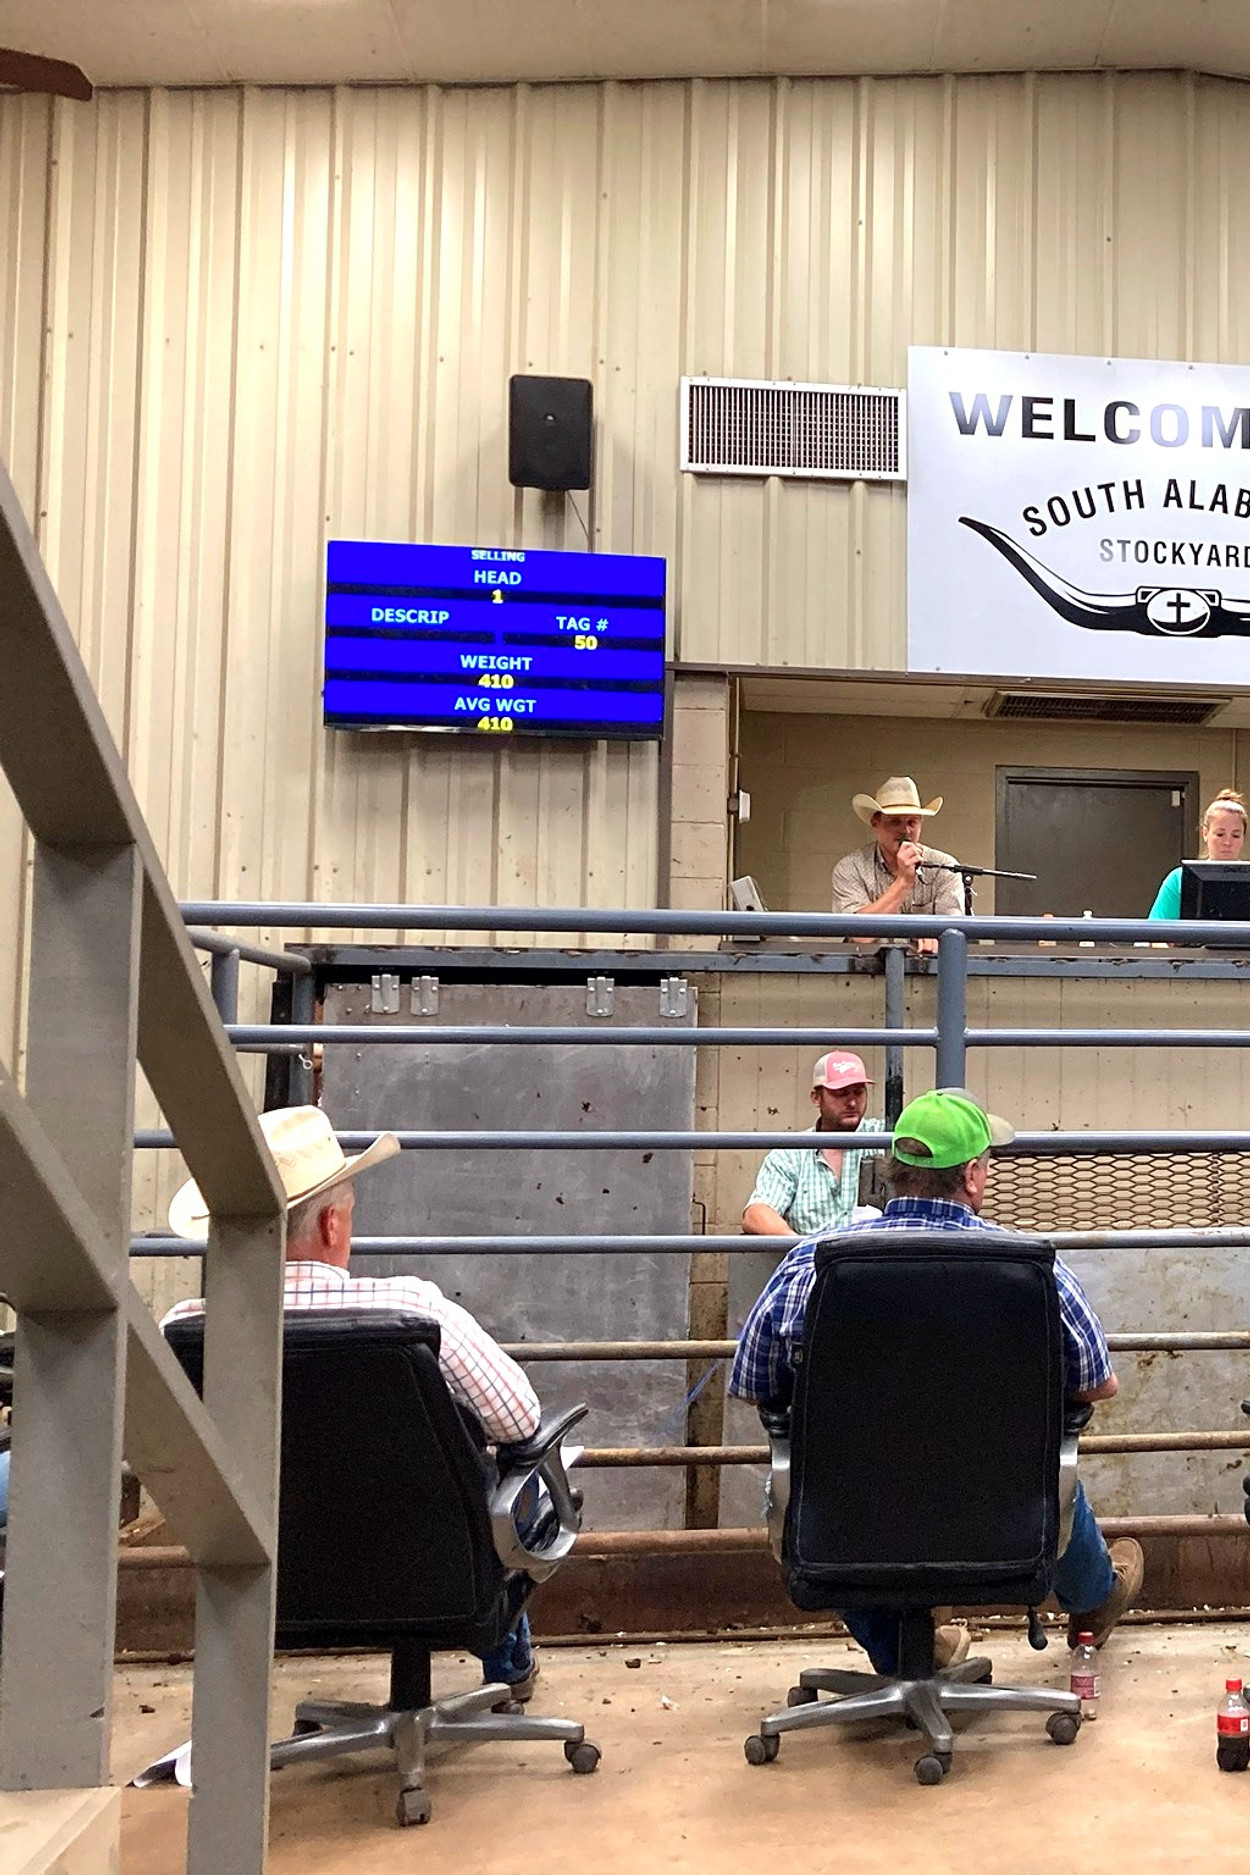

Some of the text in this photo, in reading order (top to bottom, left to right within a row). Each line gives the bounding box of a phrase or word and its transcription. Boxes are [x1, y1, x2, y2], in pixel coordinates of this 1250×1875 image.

[1022, 478, 1146, 537] SOUTH
[471, 549, 526, 563] SELLING
[473, 570, 522, 586] HEAD
[491, 589, 504, 604] 1
[371, 607, 450, 625] DESCRIP
[556, 616, 609, 632] TAG #
[574, 635, 598, 651] 50
[460, 654, 533, 672] WEIGHT
[478, 673, 514, 690] 410
[454, 697, 537, 714] AVG WGT
[477, 716, 514, 733] 410
